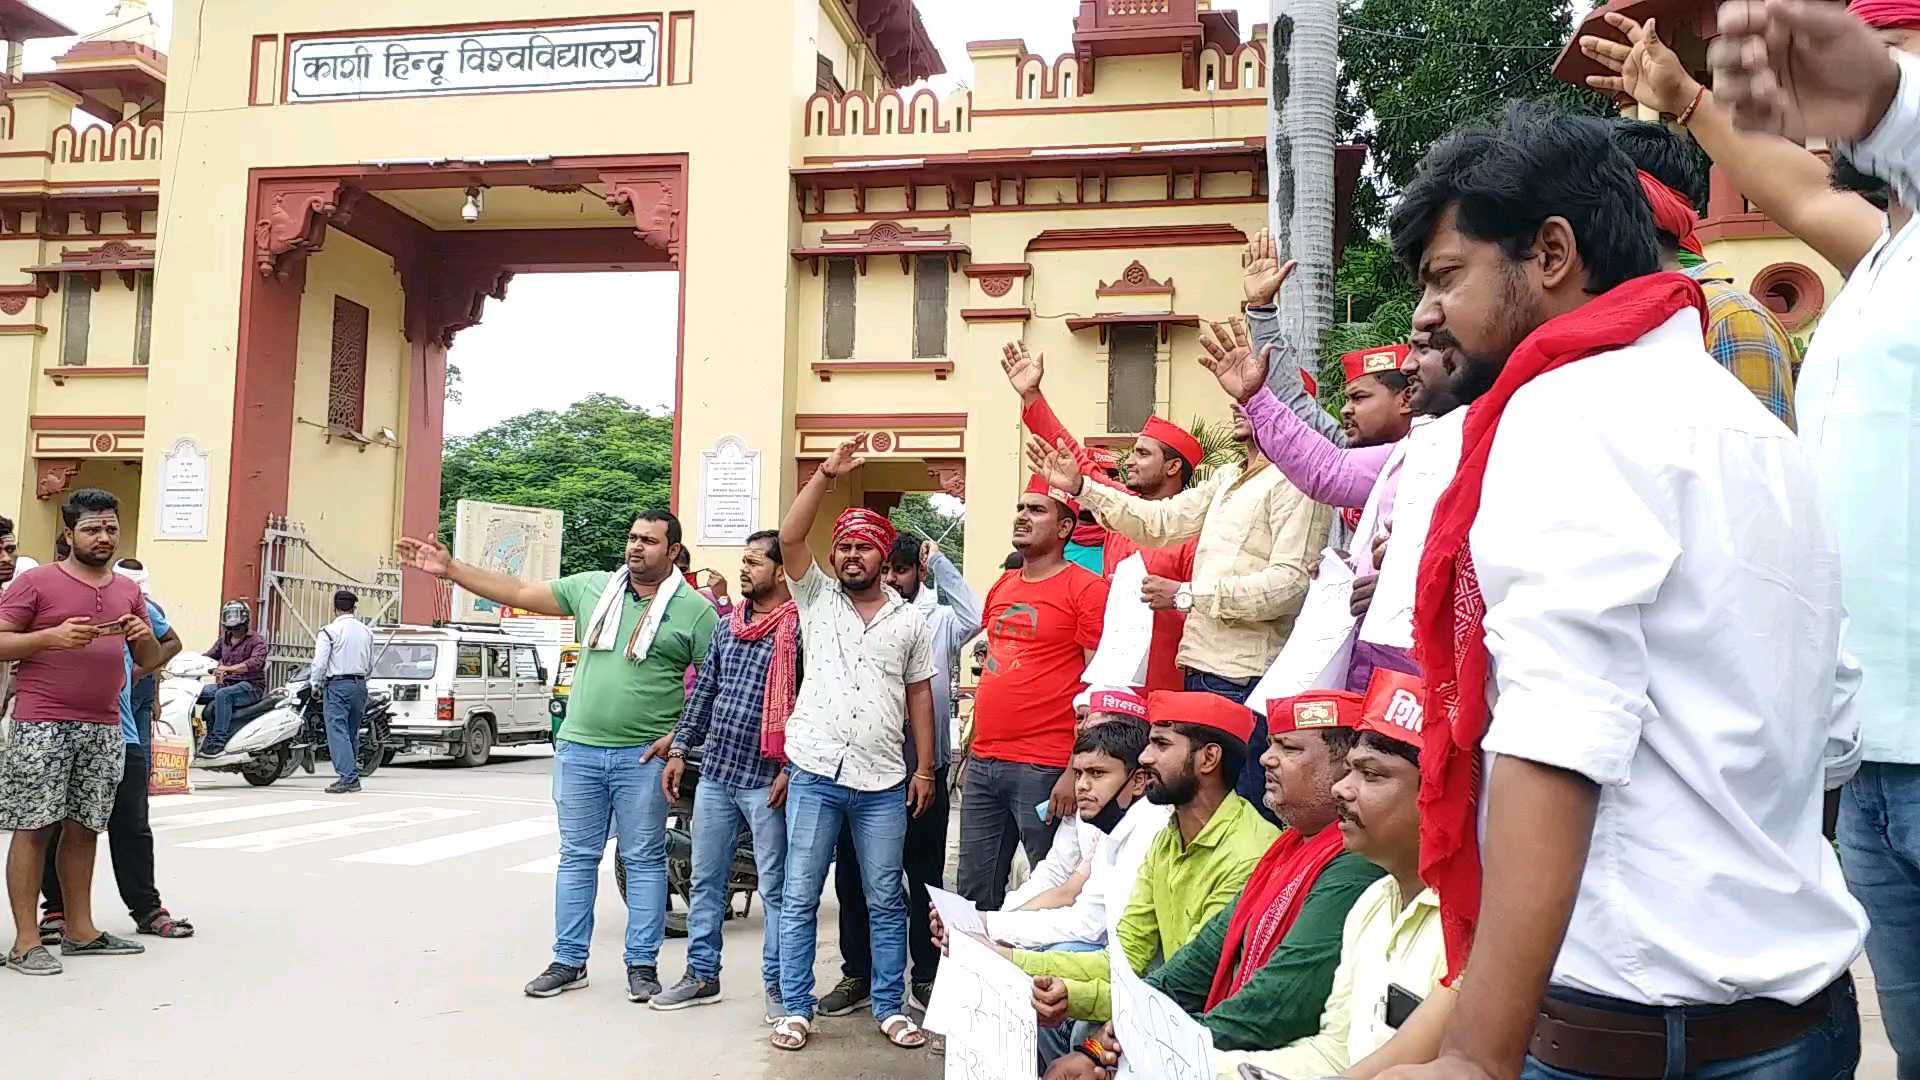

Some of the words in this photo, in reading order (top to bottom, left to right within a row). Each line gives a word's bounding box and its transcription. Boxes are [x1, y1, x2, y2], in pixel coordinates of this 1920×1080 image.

[303, 46, 373, 81] काशी
[384, 43, 448, 85] हिन्दू
[458, 35, 646, 74] विश्वविद्यालय
[1103, 694, 1147, 715] शिक्षक
[156, 752, 185, 769] GOLDEN
